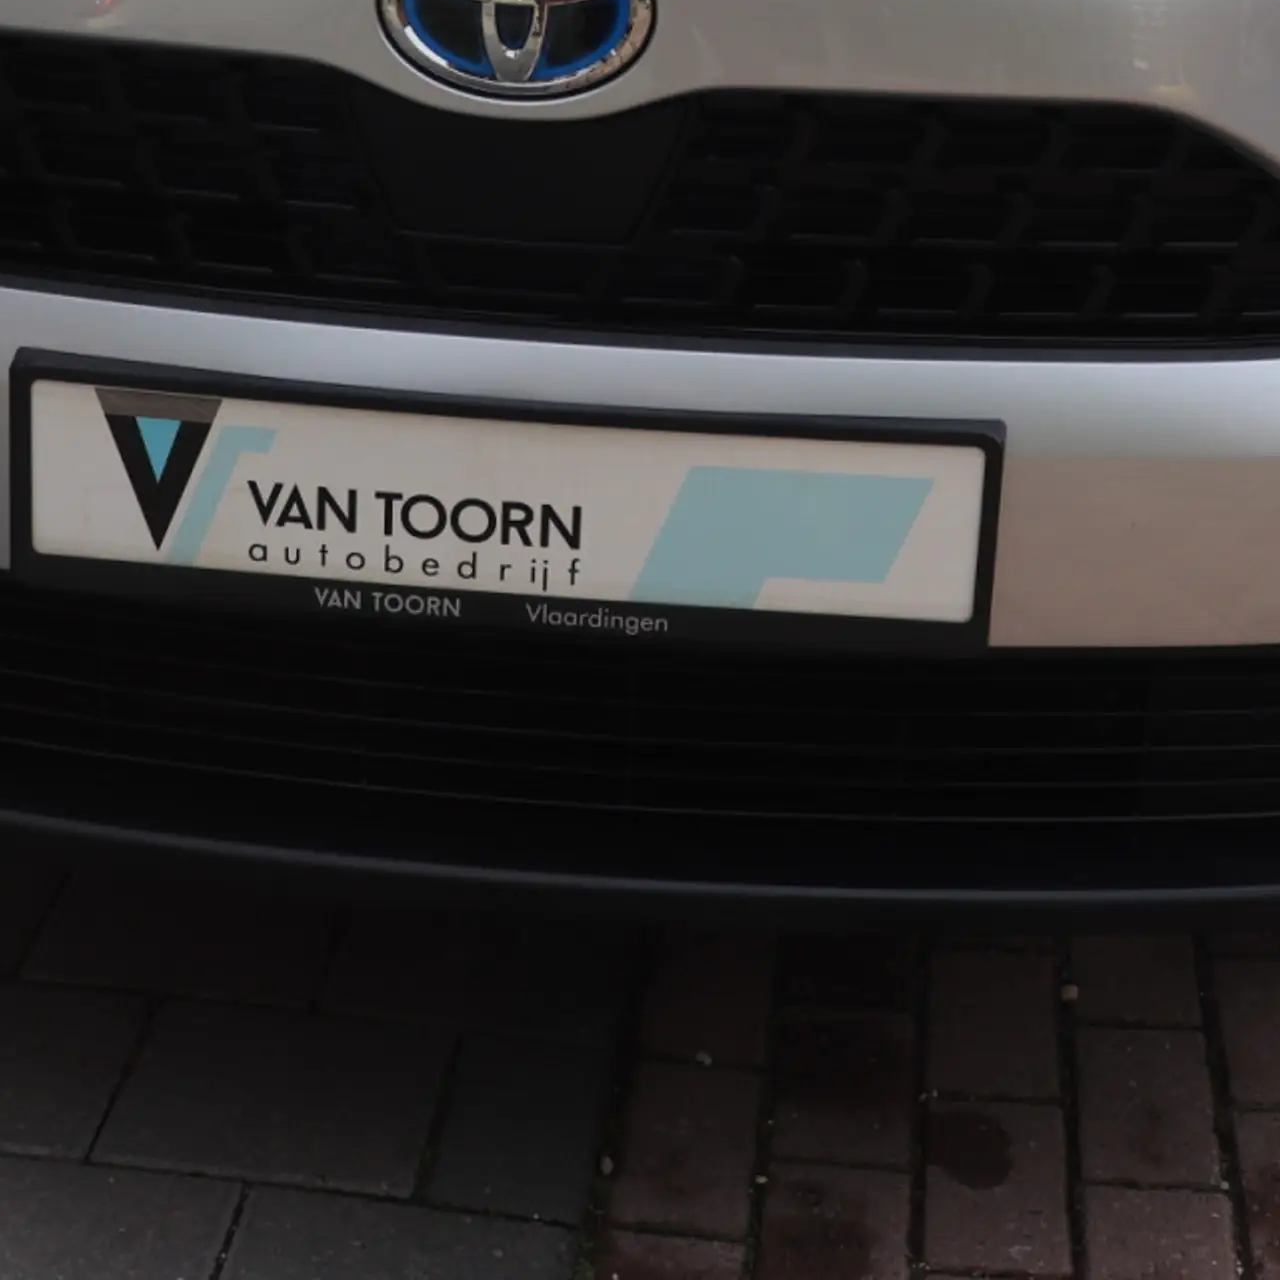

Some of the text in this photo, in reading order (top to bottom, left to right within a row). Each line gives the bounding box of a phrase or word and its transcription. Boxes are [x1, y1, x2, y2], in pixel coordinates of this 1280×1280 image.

[247, 480, 582, 551] VAN TOORN
[248, 543, 581, 592] autobedrijf
[314, 586, 669, 636] VAN TOORN Vlaardingen
